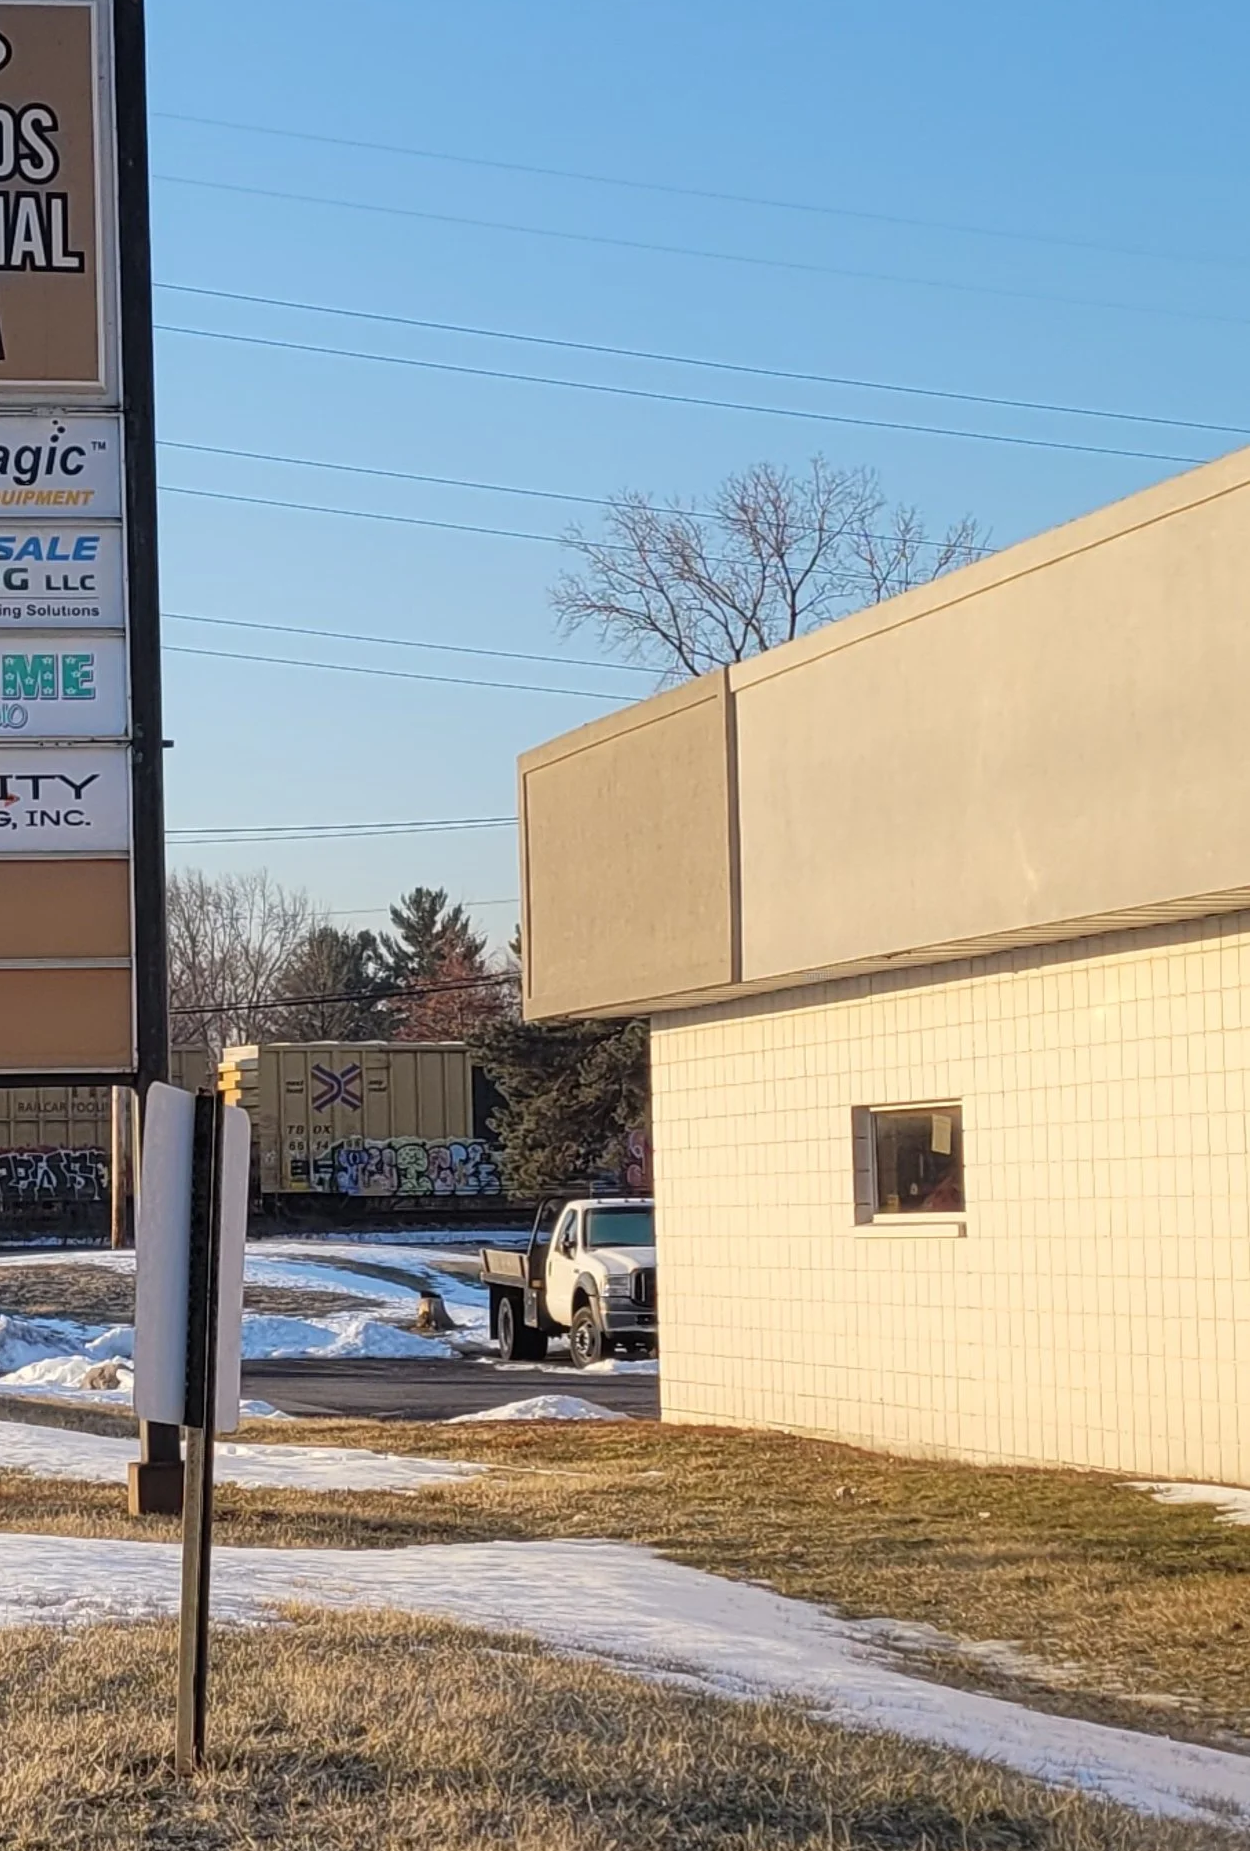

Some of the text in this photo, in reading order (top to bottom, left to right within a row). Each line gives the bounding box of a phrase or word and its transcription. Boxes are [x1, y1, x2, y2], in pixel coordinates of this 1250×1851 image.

[45, 574, 95, 591] LLC
[26, 604, 100, 618] Solutions
[1, 653, 96, 701] ME
[25, 809, 92, 827] INC.
